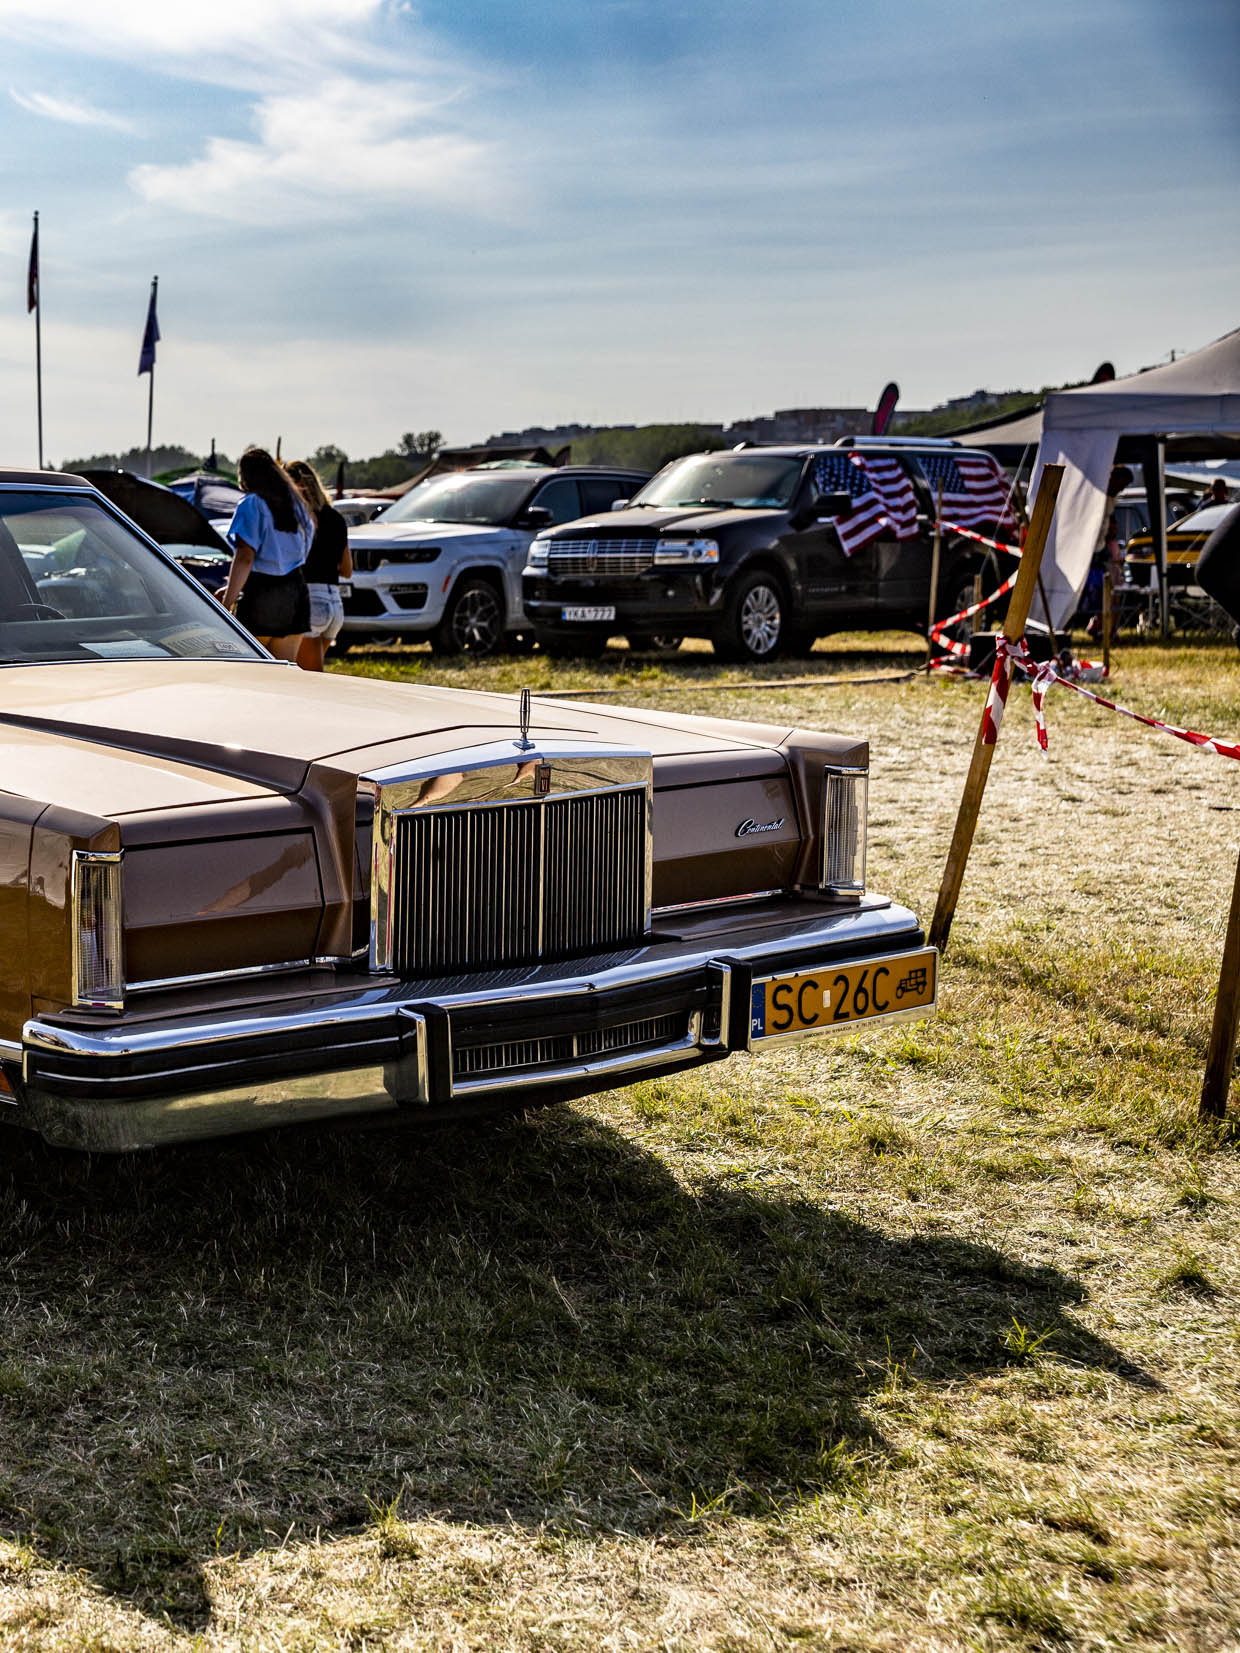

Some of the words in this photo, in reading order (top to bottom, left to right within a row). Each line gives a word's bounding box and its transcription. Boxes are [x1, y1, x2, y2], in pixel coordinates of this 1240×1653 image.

[737, 818, 785, 837] Continental
[772, 979, 820, 1030] SC
[833, 967, 890, 1021] 26C
[751, 1017, 764, 1032] PL
